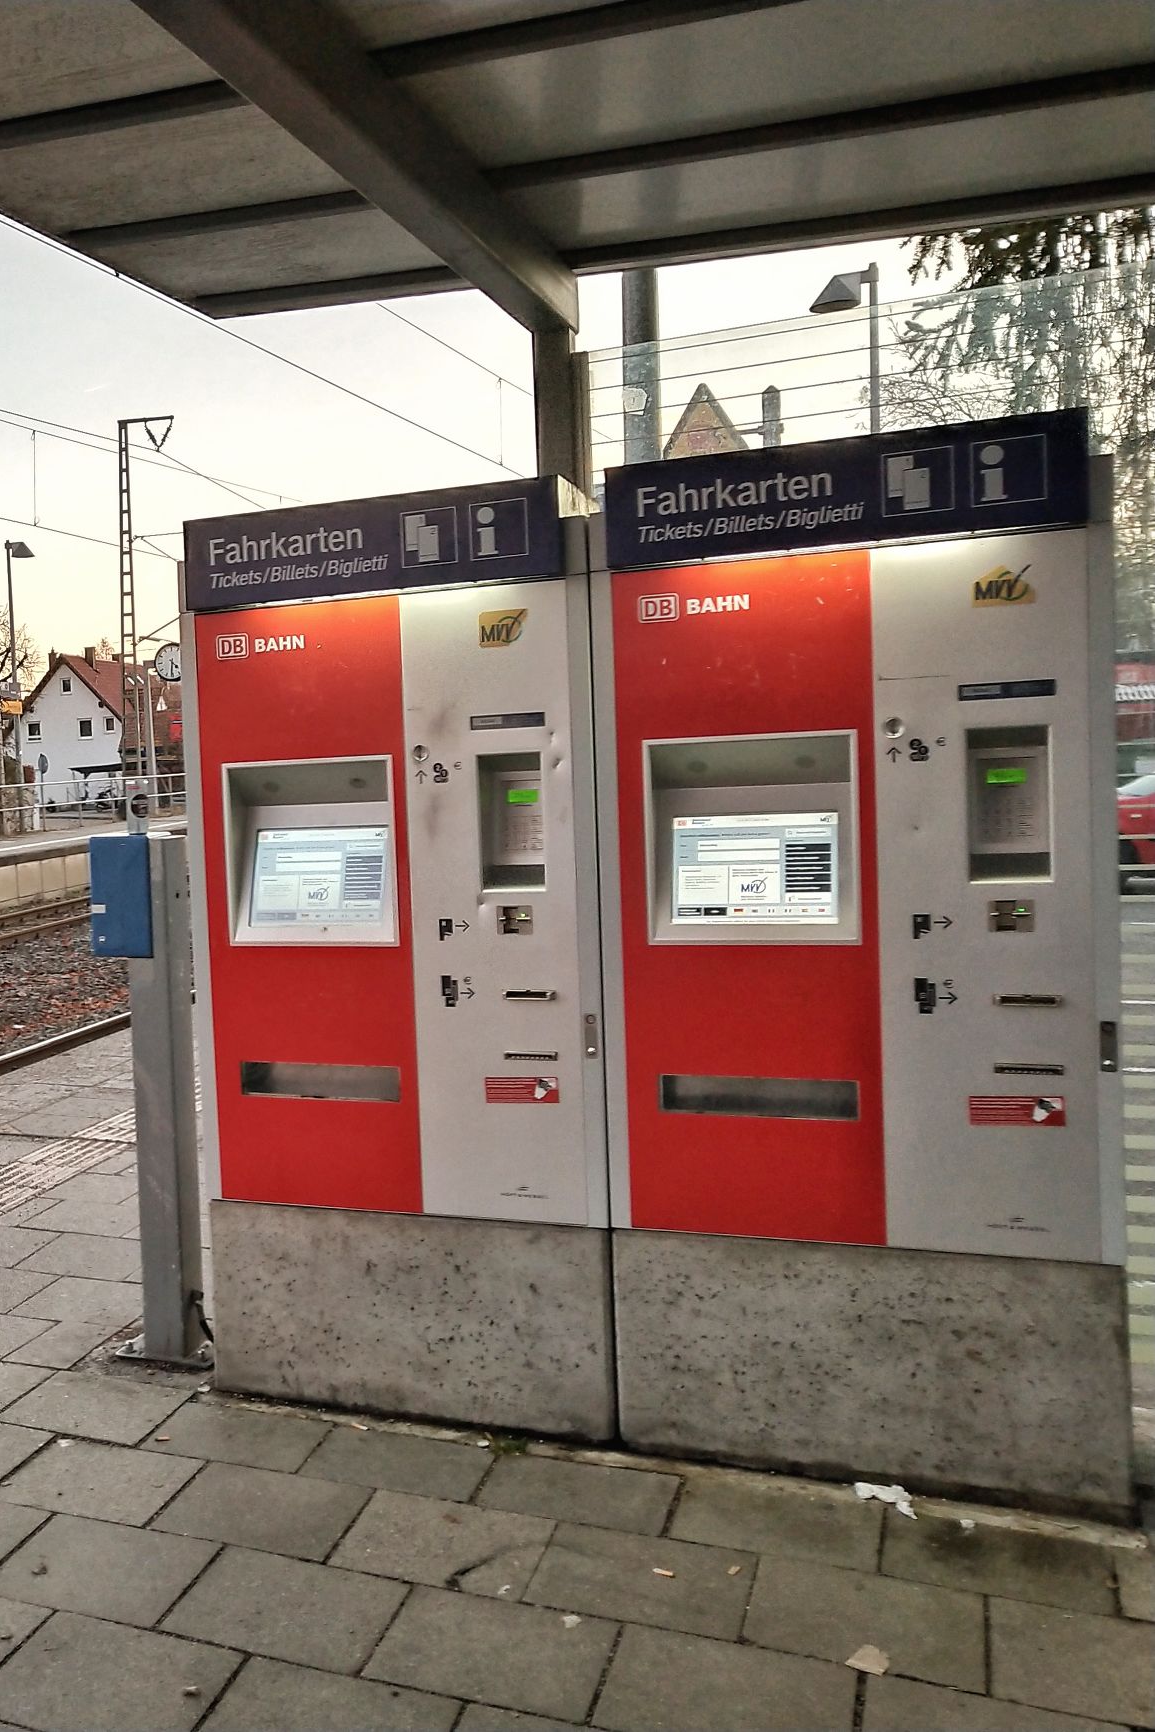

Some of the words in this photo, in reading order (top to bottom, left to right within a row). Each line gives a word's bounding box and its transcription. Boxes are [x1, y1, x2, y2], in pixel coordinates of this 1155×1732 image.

[636, 469, 833, 518] Fahrkarten
[637, 502, 865, 544] Tickets/Billets/Biglietti
[209, 525, 364, 567] Fahrkarten
[209, 554, 390, 590] Tickets/Billets/Biglietti
[643, 597, 674, 619] DB
[686, 594, 750, 616] BAHN
[254, 634, 306, 654] BAHN
